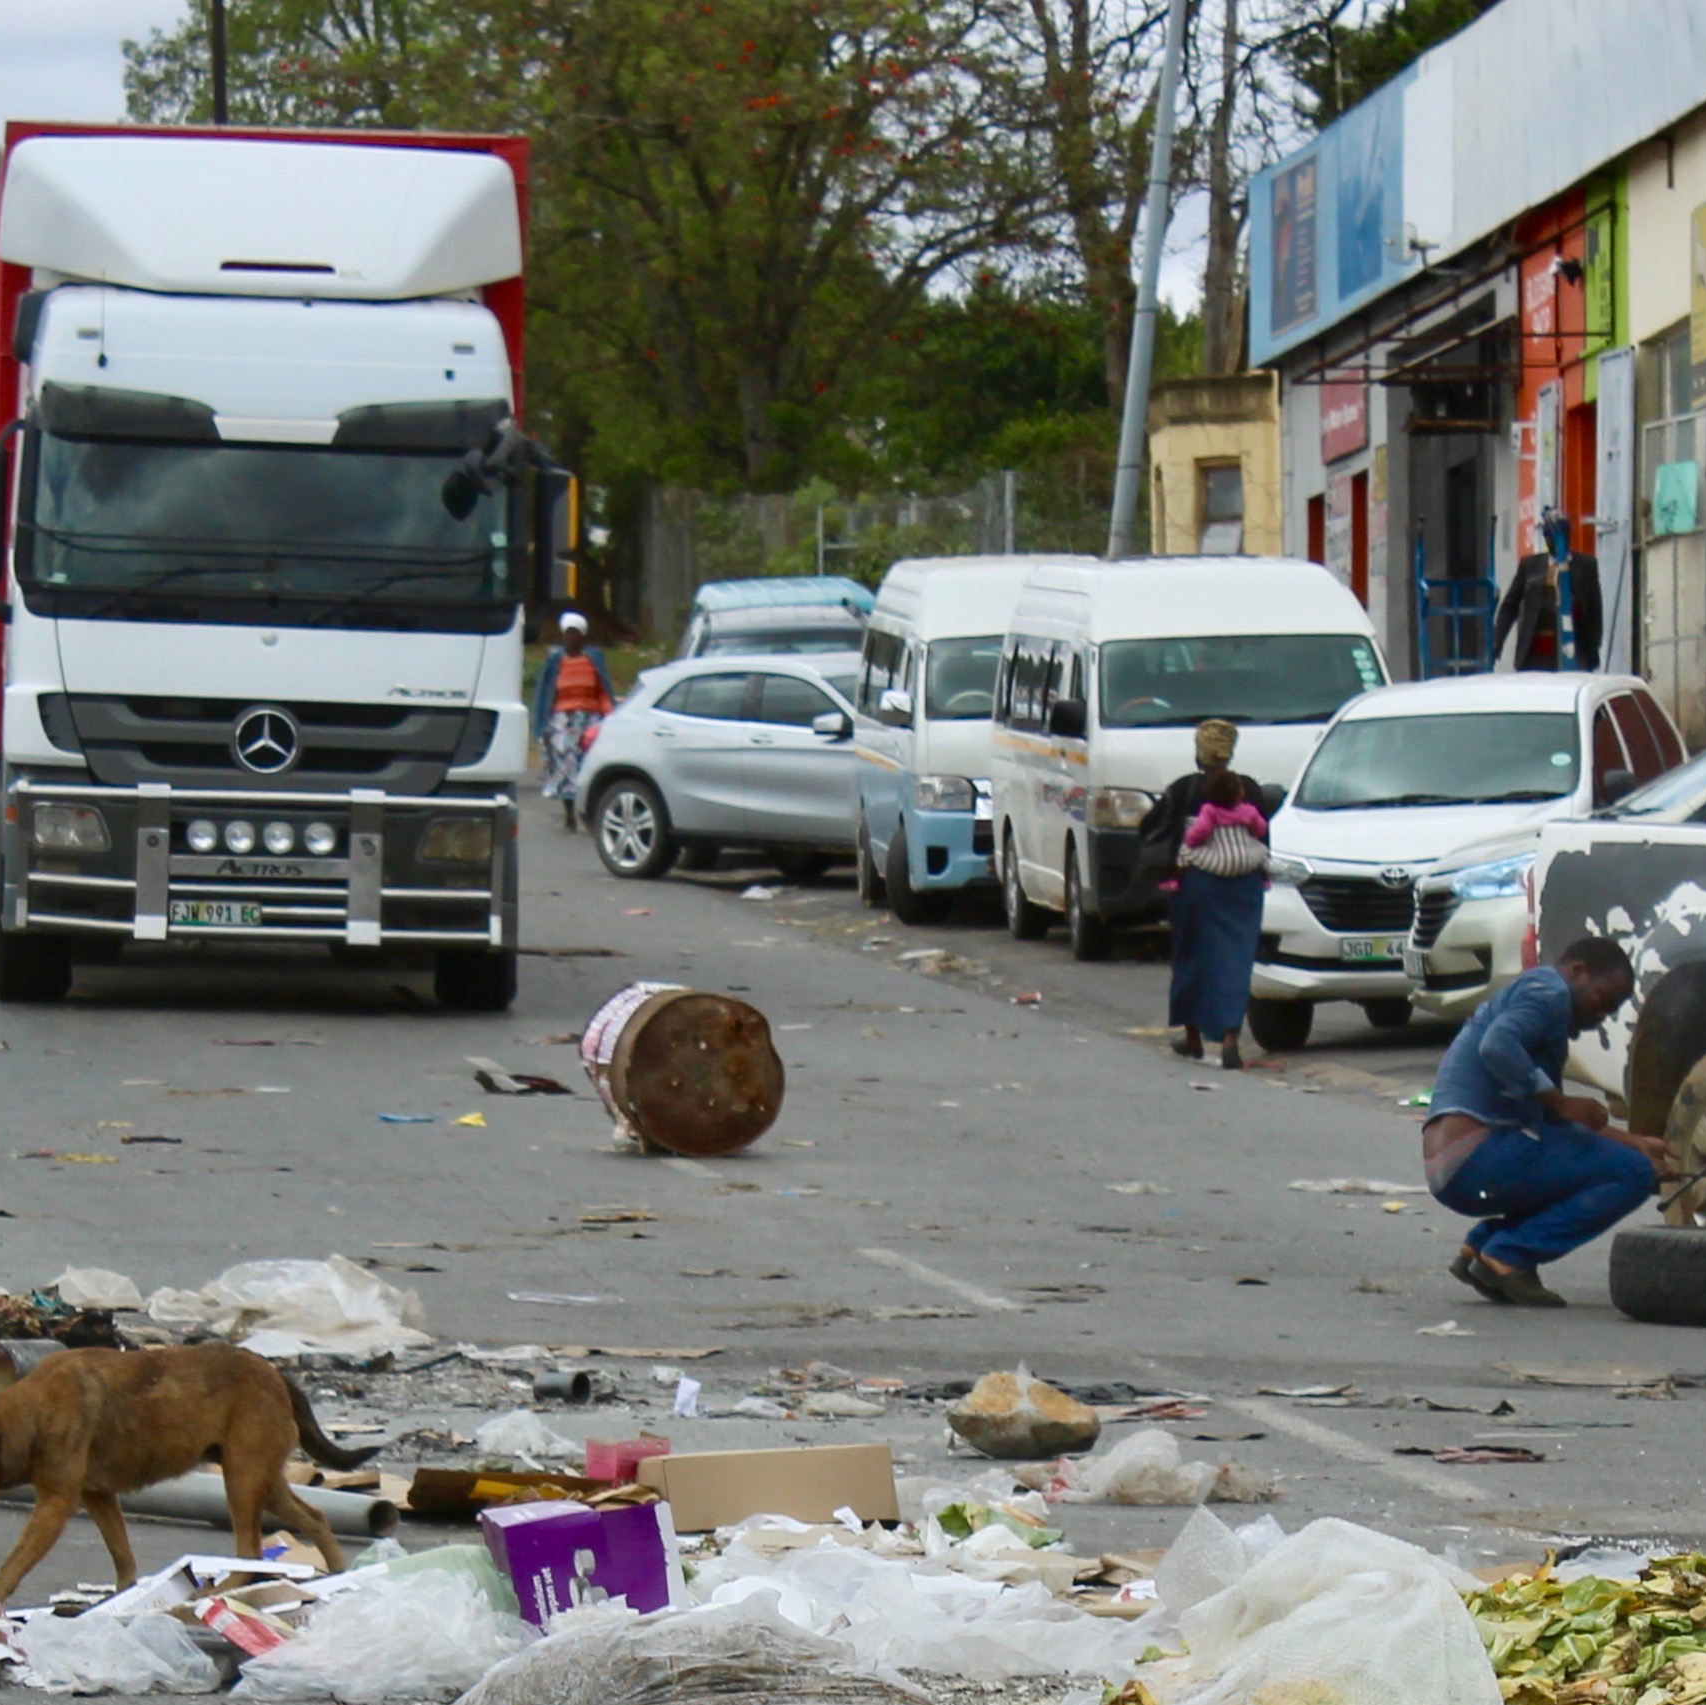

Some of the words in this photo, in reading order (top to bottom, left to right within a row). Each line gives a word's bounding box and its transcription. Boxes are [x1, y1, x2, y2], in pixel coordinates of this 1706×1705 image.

[172, 903, 201, 922] FJW
[206, 904, 233, 923] 991
[240, 905, 257, 923] EC
